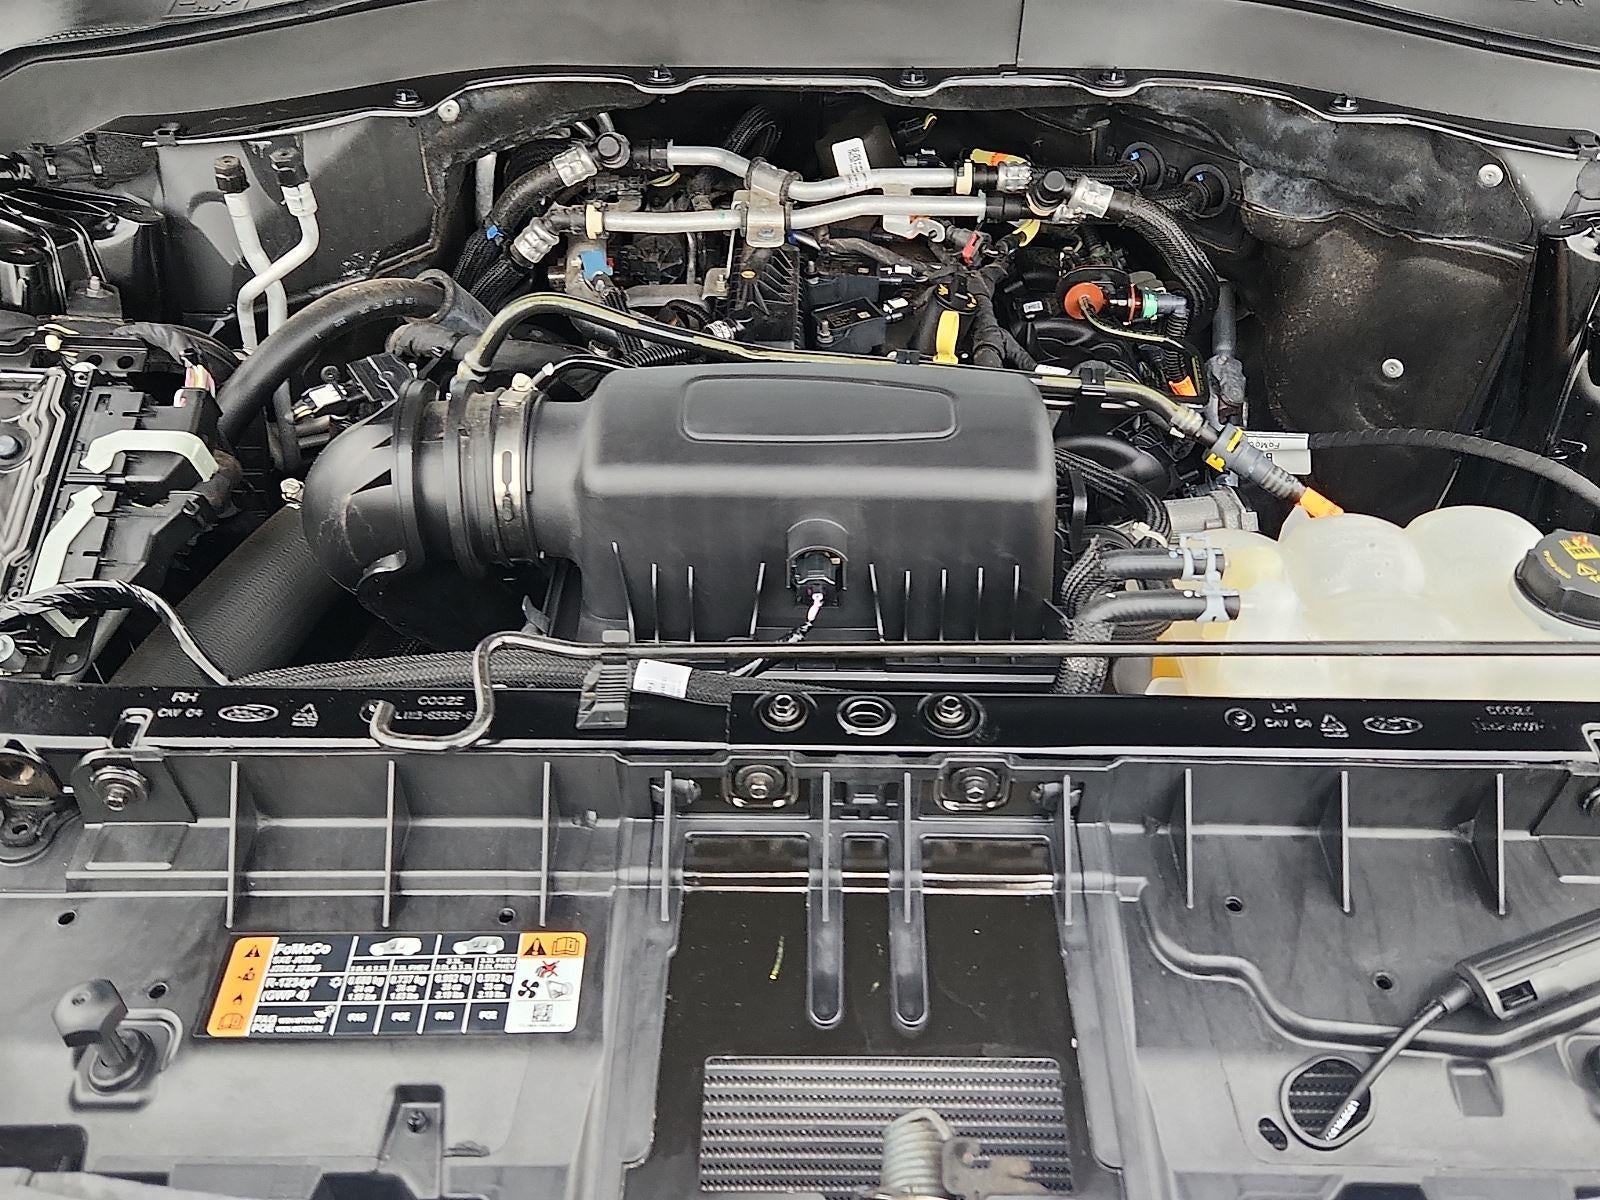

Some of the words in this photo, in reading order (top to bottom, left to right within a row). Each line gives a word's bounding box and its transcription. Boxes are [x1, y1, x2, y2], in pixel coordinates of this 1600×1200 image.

[1247, 440, 1280, 450] FoMoC
[170, 691, 200, 703] RH
[1271, 702, 1298, 713] LH
[274, 943, 331, 955] FoMoCo
[265, 976, 318, 989] R-1234yf
